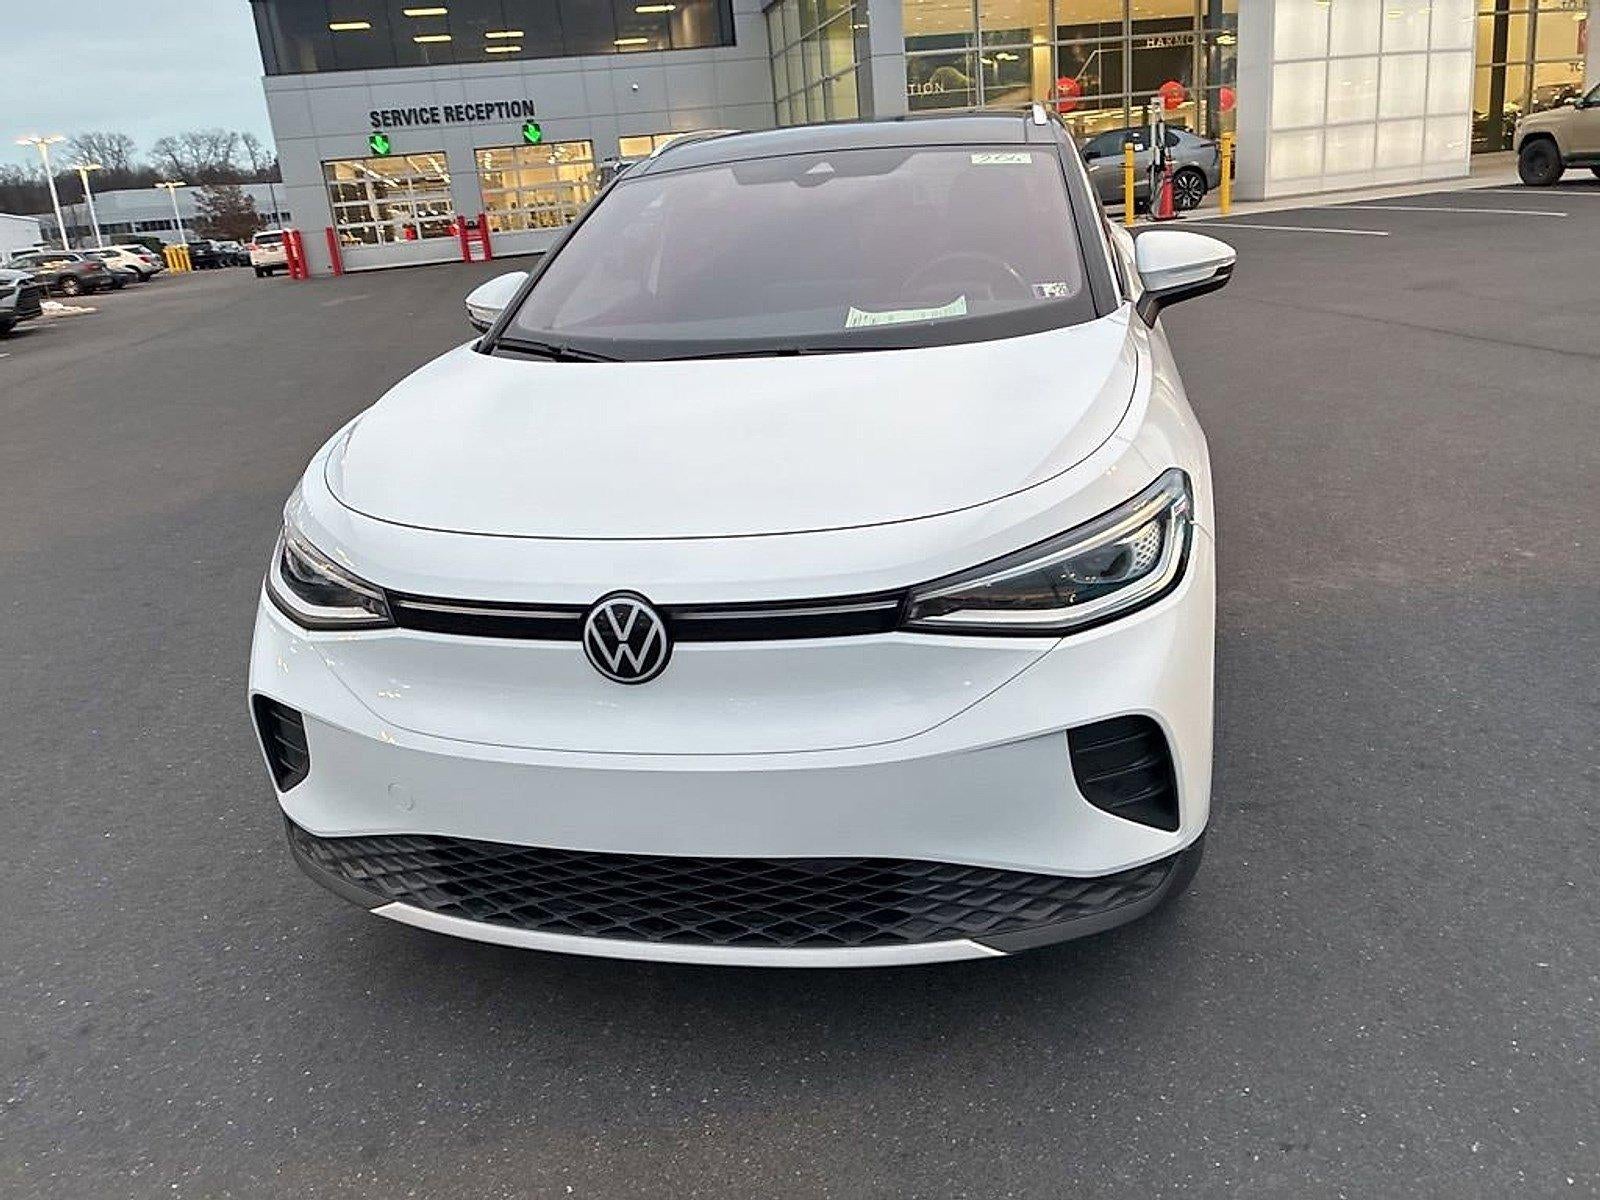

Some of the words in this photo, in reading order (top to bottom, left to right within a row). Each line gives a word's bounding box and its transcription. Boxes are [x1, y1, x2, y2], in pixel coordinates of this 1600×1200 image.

[1146, 34, 1200, 48] HARMO
[904, 82, 944, 96] TION
[370, 107, 440, 128] SERVICE
[444, 100, 535, 123] RECEPTION
